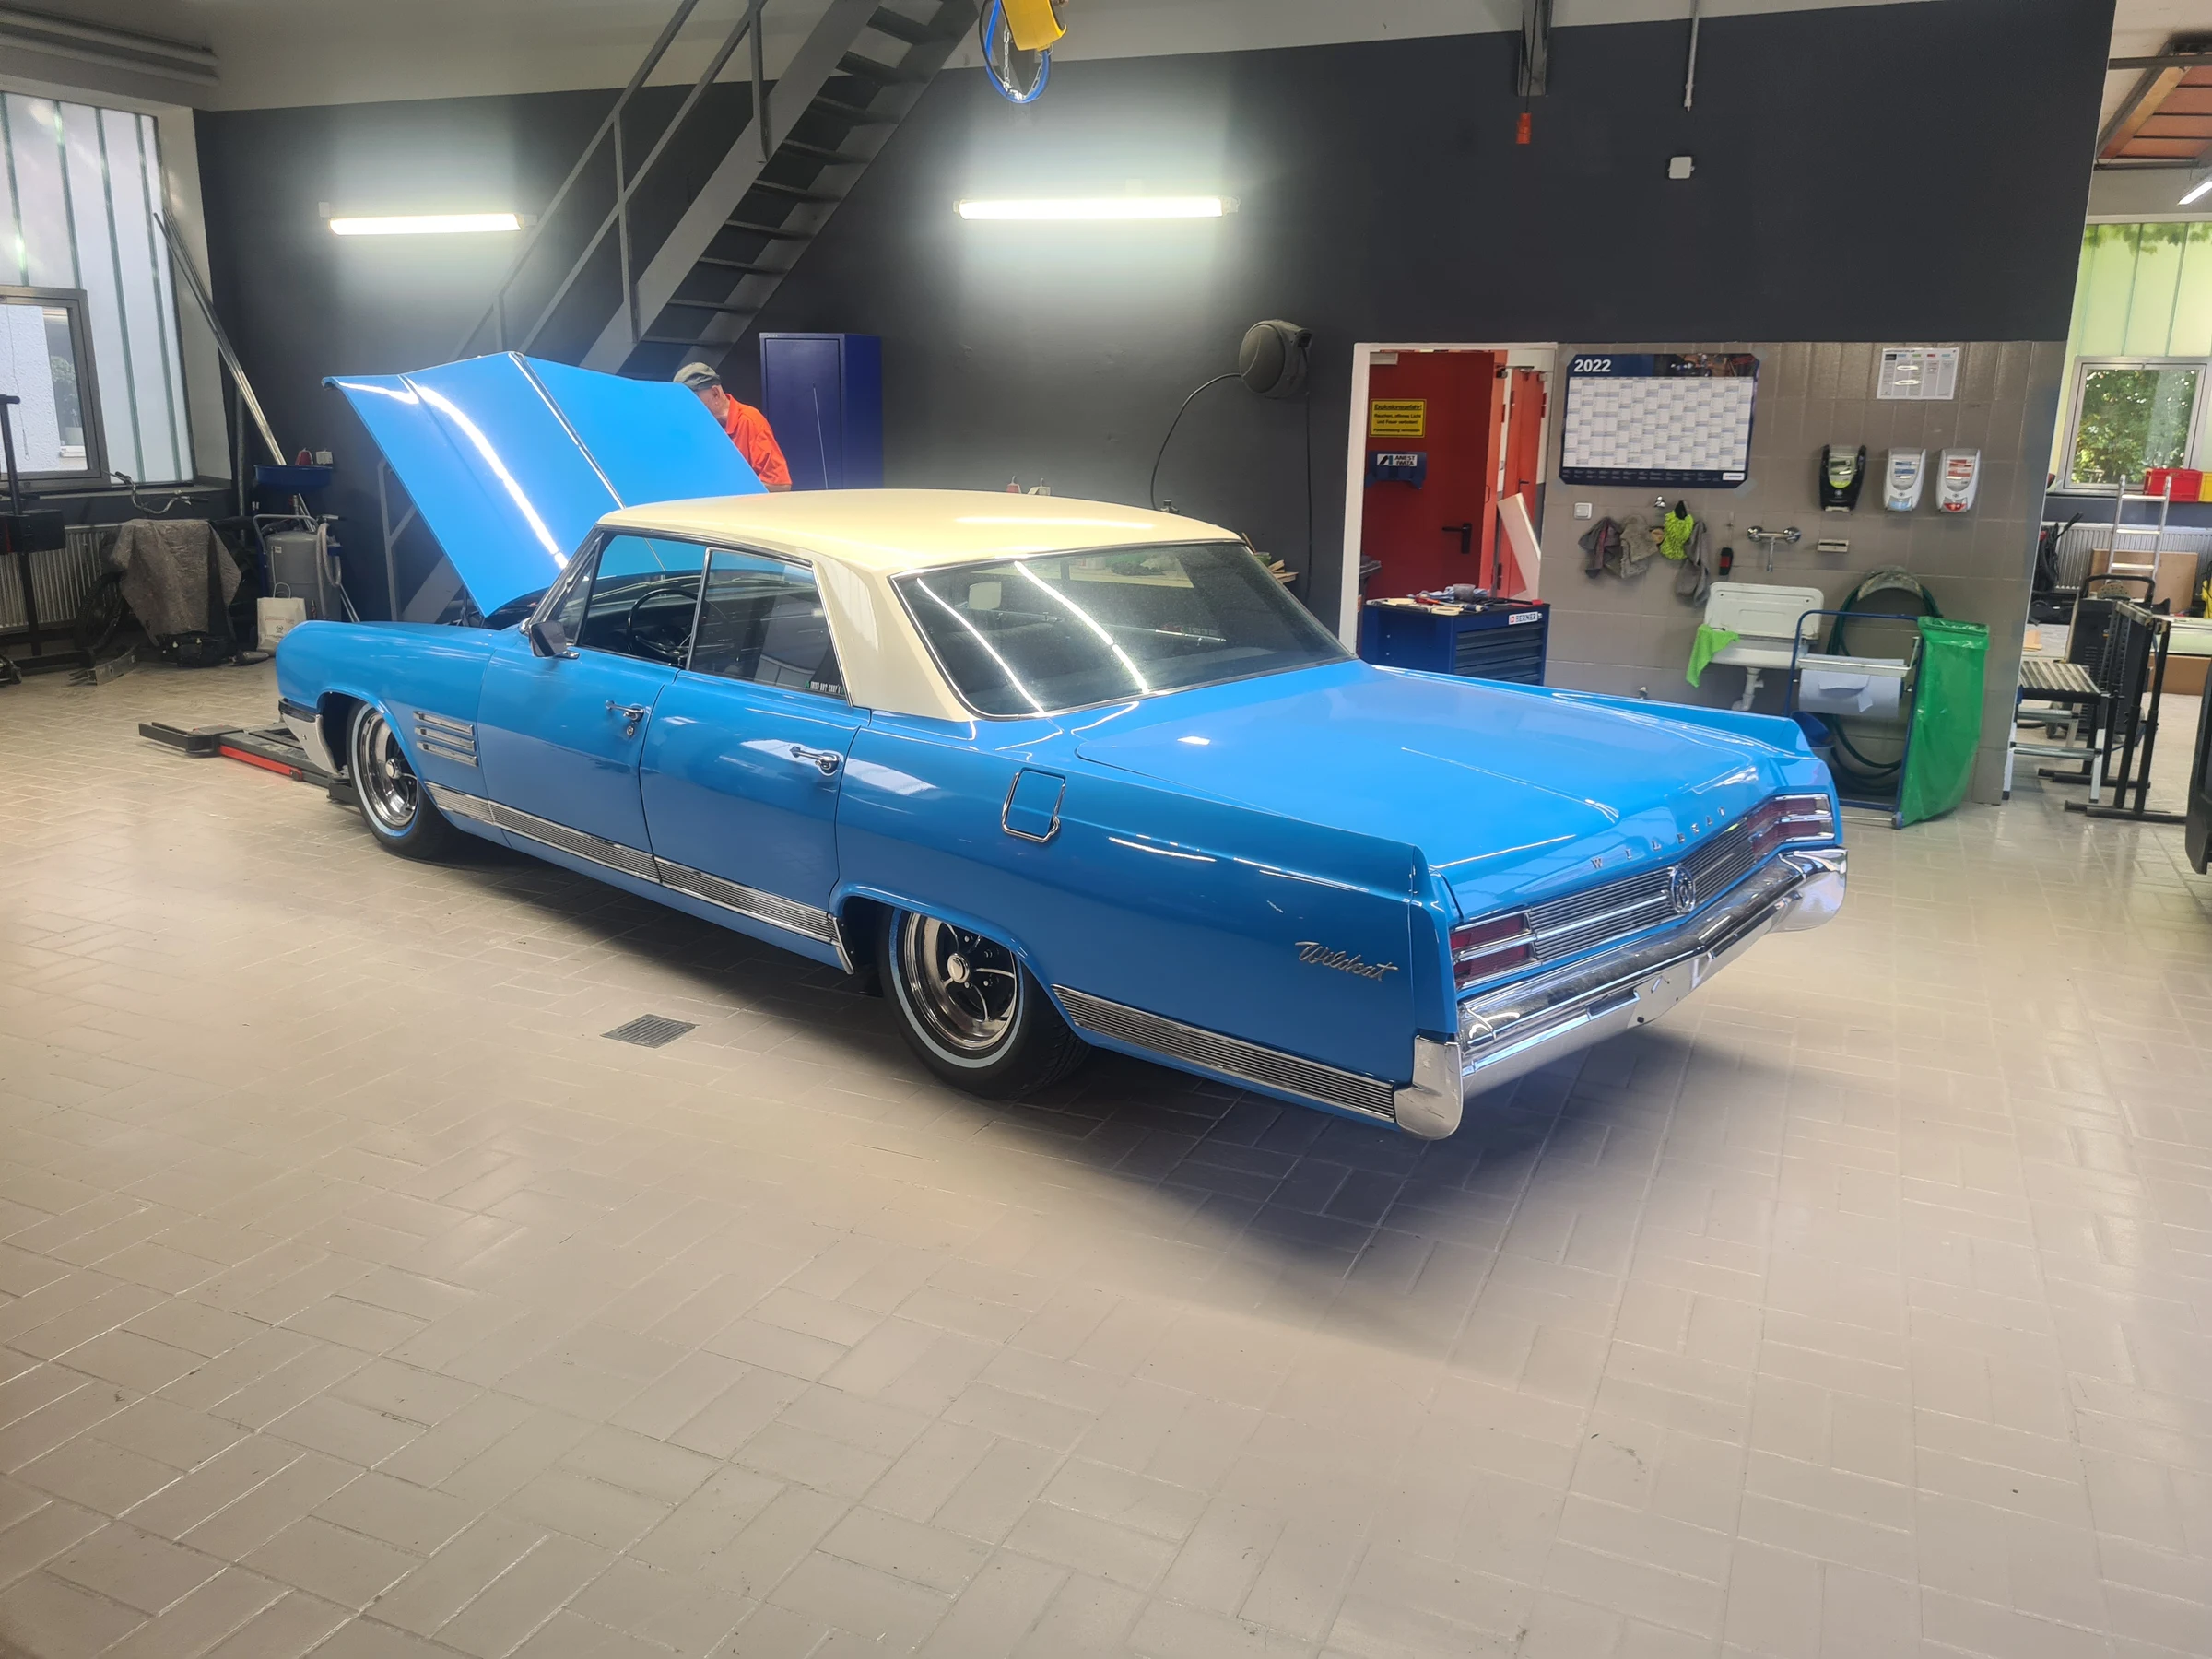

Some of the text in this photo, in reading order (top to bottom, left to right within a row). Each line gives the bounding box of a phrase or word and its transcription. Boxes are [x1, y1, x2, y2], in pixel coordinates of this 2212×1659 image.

[1573, 359, 1612, 372] 2022
[1515, 613, 1536, 623] BERNER
[1294, 941, 1399, 982] Wildcat
